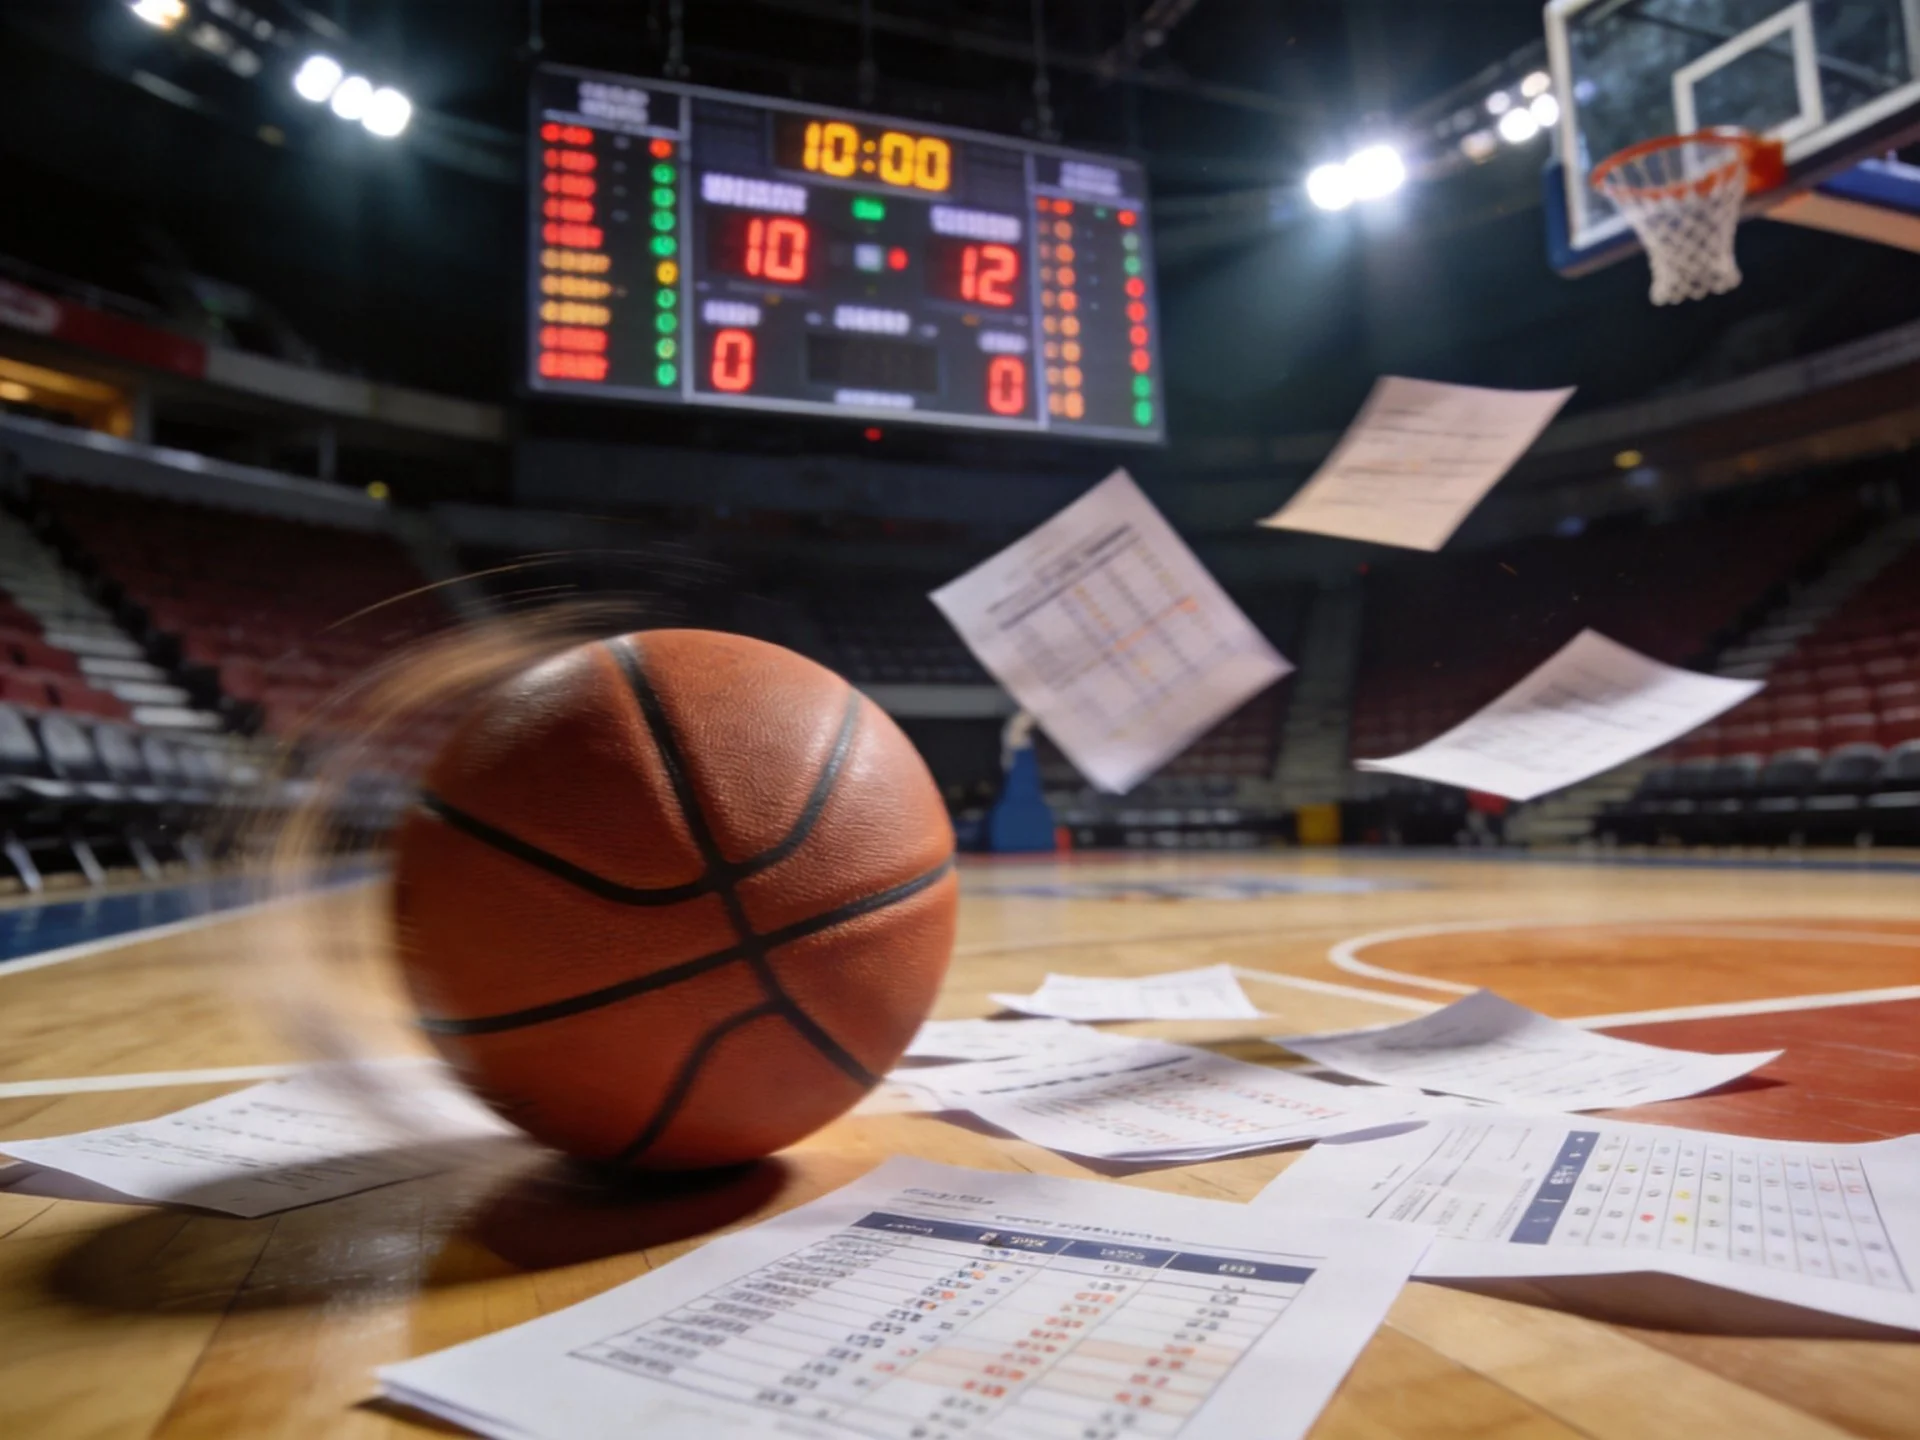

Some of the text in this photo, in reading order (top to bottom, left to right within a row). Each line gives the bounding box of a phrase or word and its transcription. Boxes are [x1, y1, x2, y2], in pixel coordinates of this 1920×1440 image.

[802, 120, 951, 191] 10:00
[745, 217, 808, 282] 10
[960, 244, 1018, 307] 12
[711, 327, 754, 392] 0
[986, 355, 1026, 415] 0
